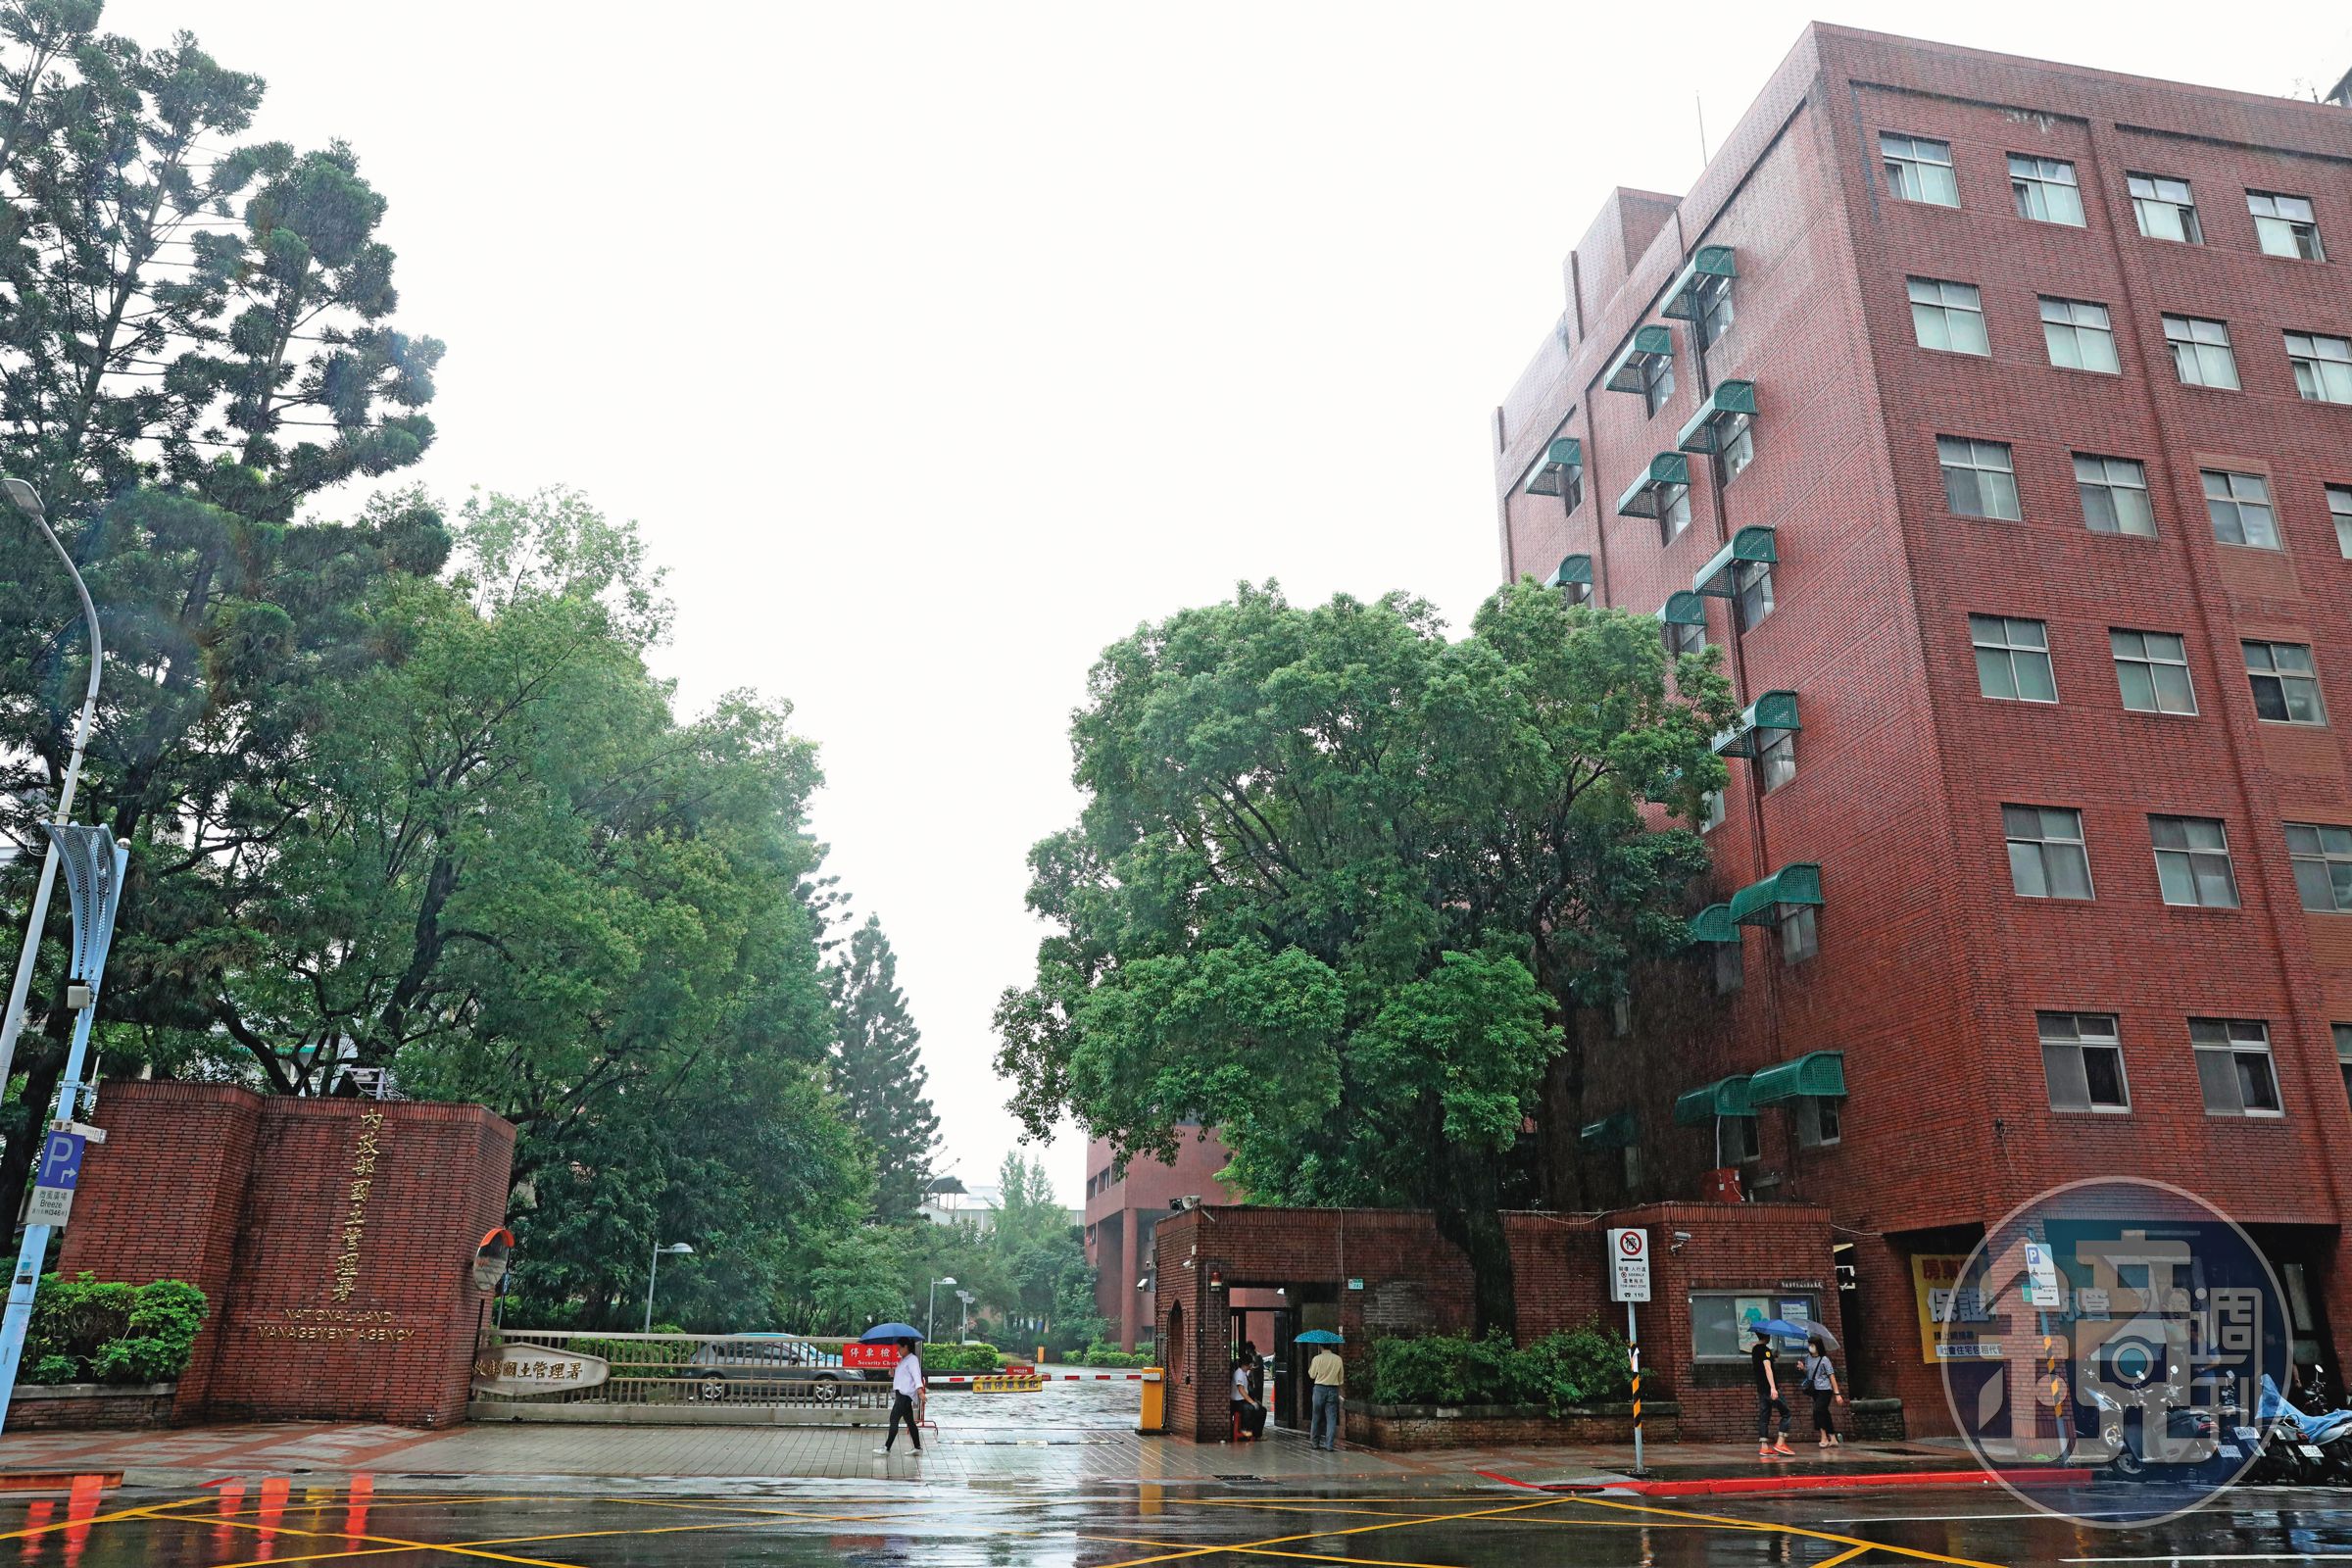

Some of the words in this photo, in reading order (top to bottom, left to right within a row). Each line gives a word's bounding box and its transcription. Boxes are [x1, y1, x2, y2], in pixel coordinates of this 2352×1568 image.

[44, 1136, 74, 1178] P
[40, 1199, 63, 1208] Breeze
[331, 1108, 383, 1303] 內政部國土管理署
[285, 1309, 352, 1322] NATIONAL
[356, 1311, 393, 1323] LAND
[257, 1326, 355, 1341] MANAGEMENT
[357, 1329, 416, 1342] AGENCY
